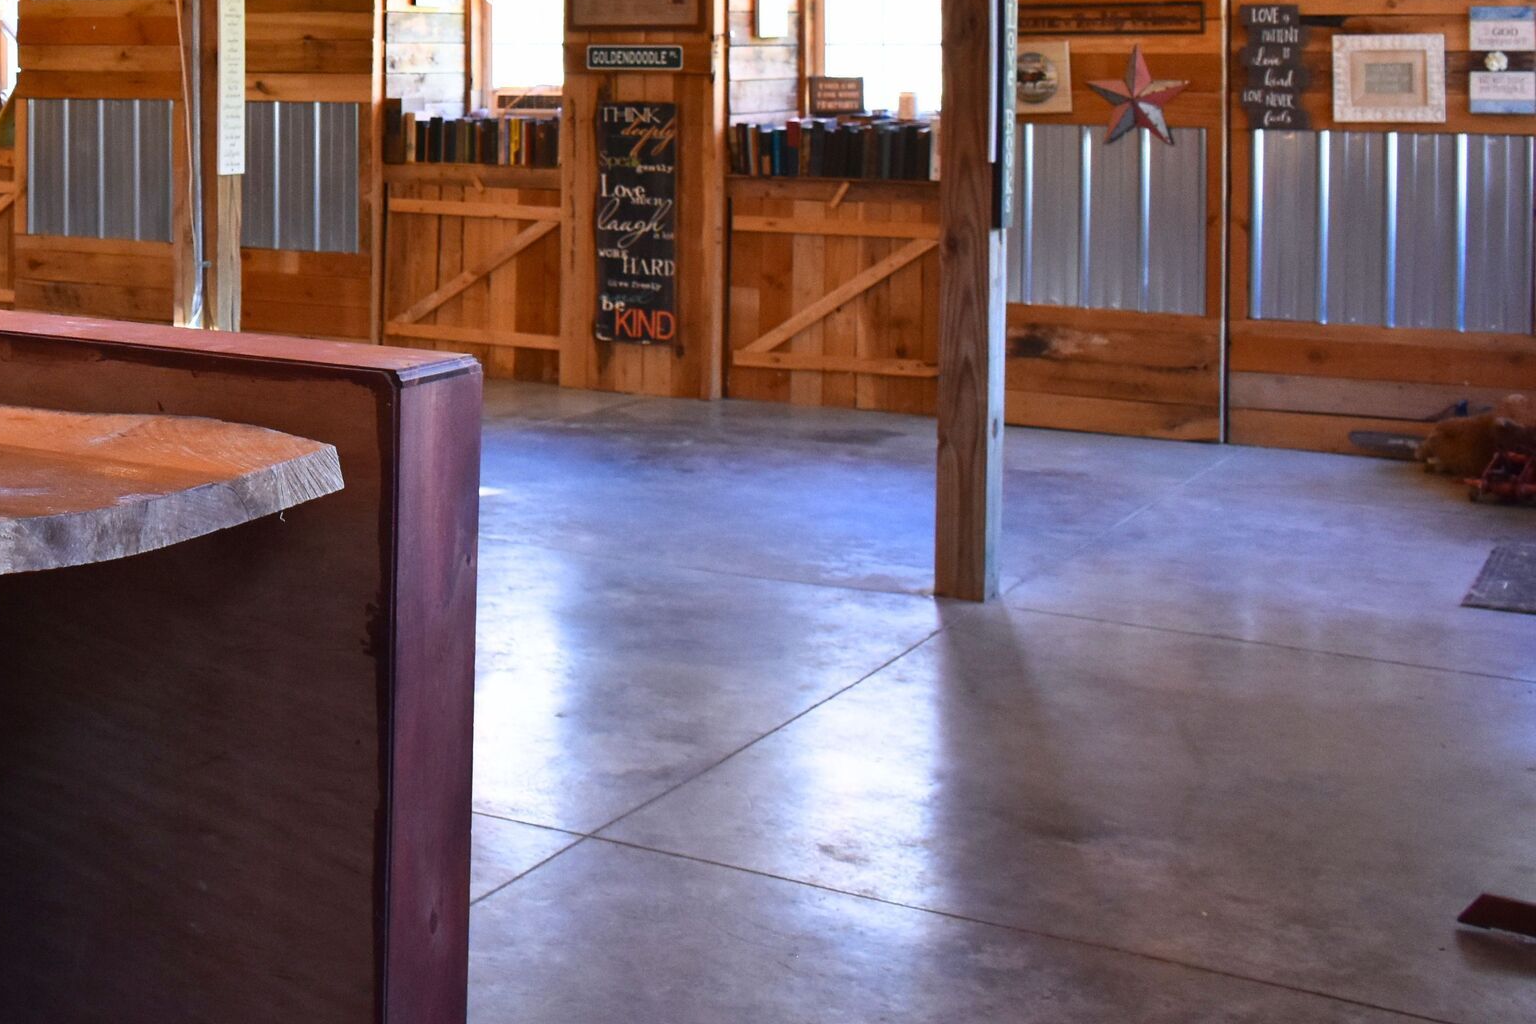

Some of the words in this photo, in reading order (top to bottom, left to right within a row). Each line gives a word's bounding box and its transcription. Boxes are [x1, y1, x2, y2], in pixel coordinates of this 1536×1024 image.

[1251, 6, 1279, 25] LOVE
[591, 50, 668, 66] GOLDENDOODLE
[1243, 89, 1264, 104] LOVE
[1265, 92, 1295, 109] NEVER
[603, 106, 662, 124] THINK
[597, 197, 673, 249] laugh
[623, 257, 676, 277] HARD
[601, 294, 626, 313] be
[614, 308, 677, 340] KIND
